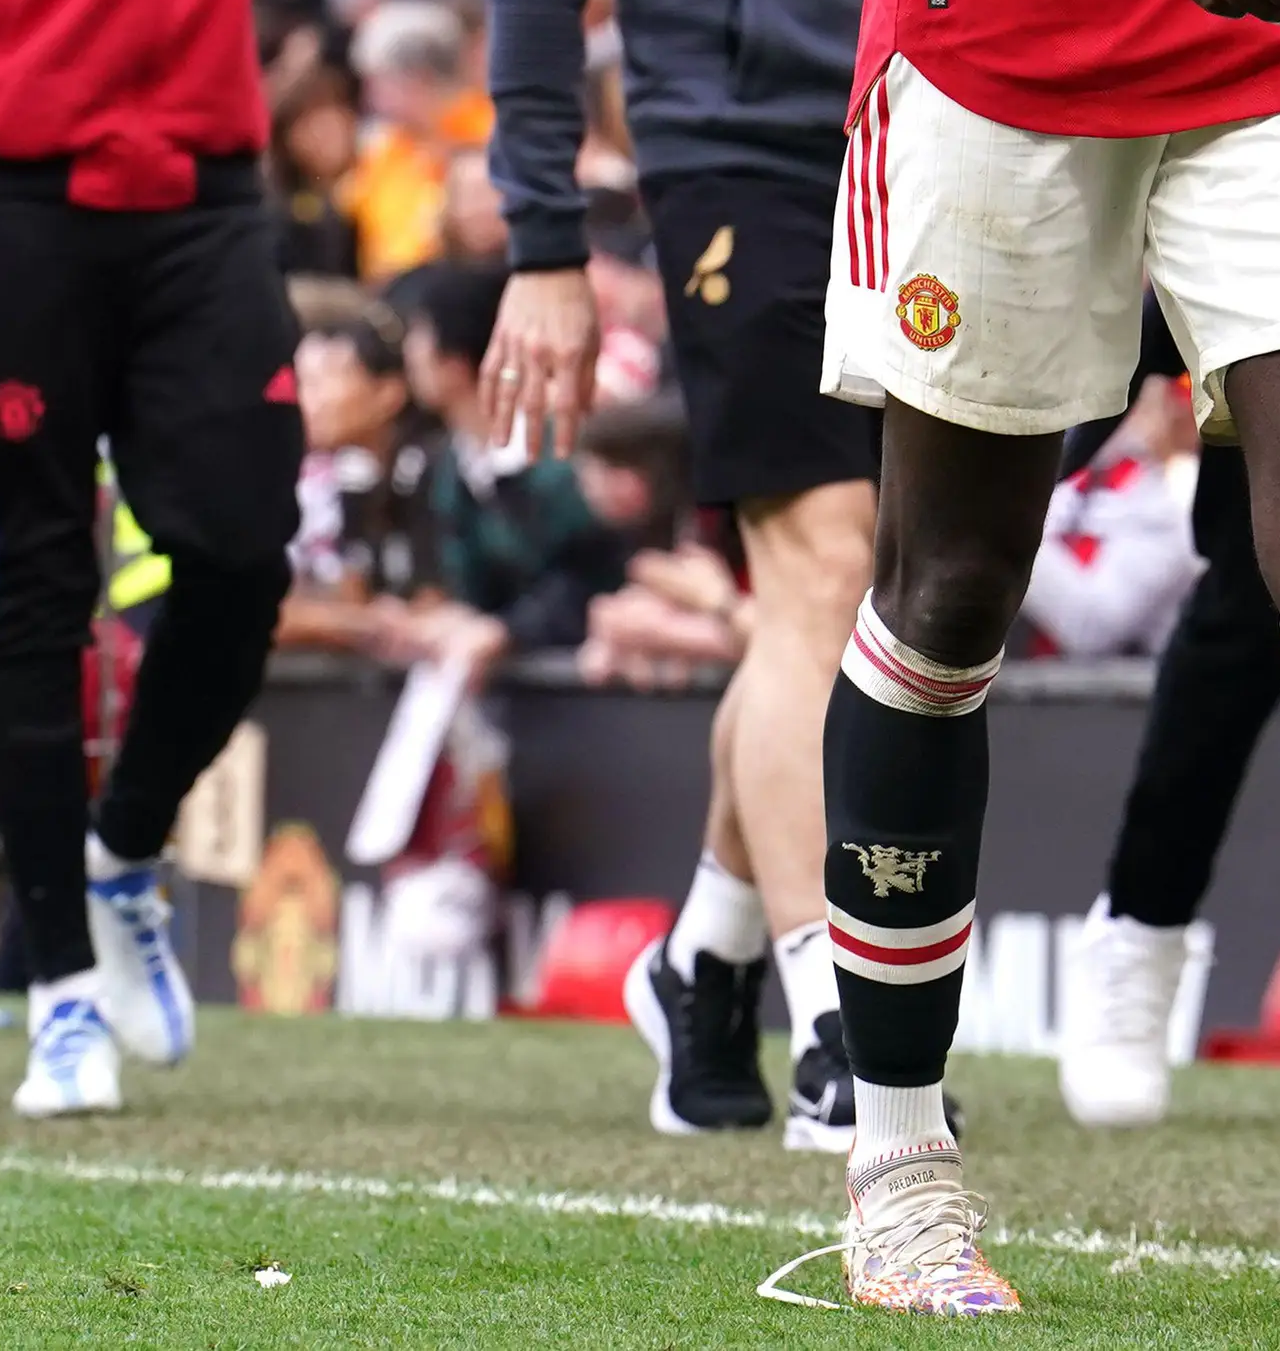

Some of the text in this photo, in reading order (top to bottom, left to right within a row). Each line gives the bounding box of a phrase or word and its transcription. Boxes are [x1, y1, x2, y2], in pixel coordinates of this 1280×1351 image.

[901, 279, 953, 308] MANCHESTER
[909, 330, 945, 346] UNITED
[888, 1170, 937, 1195] PREDATOR
